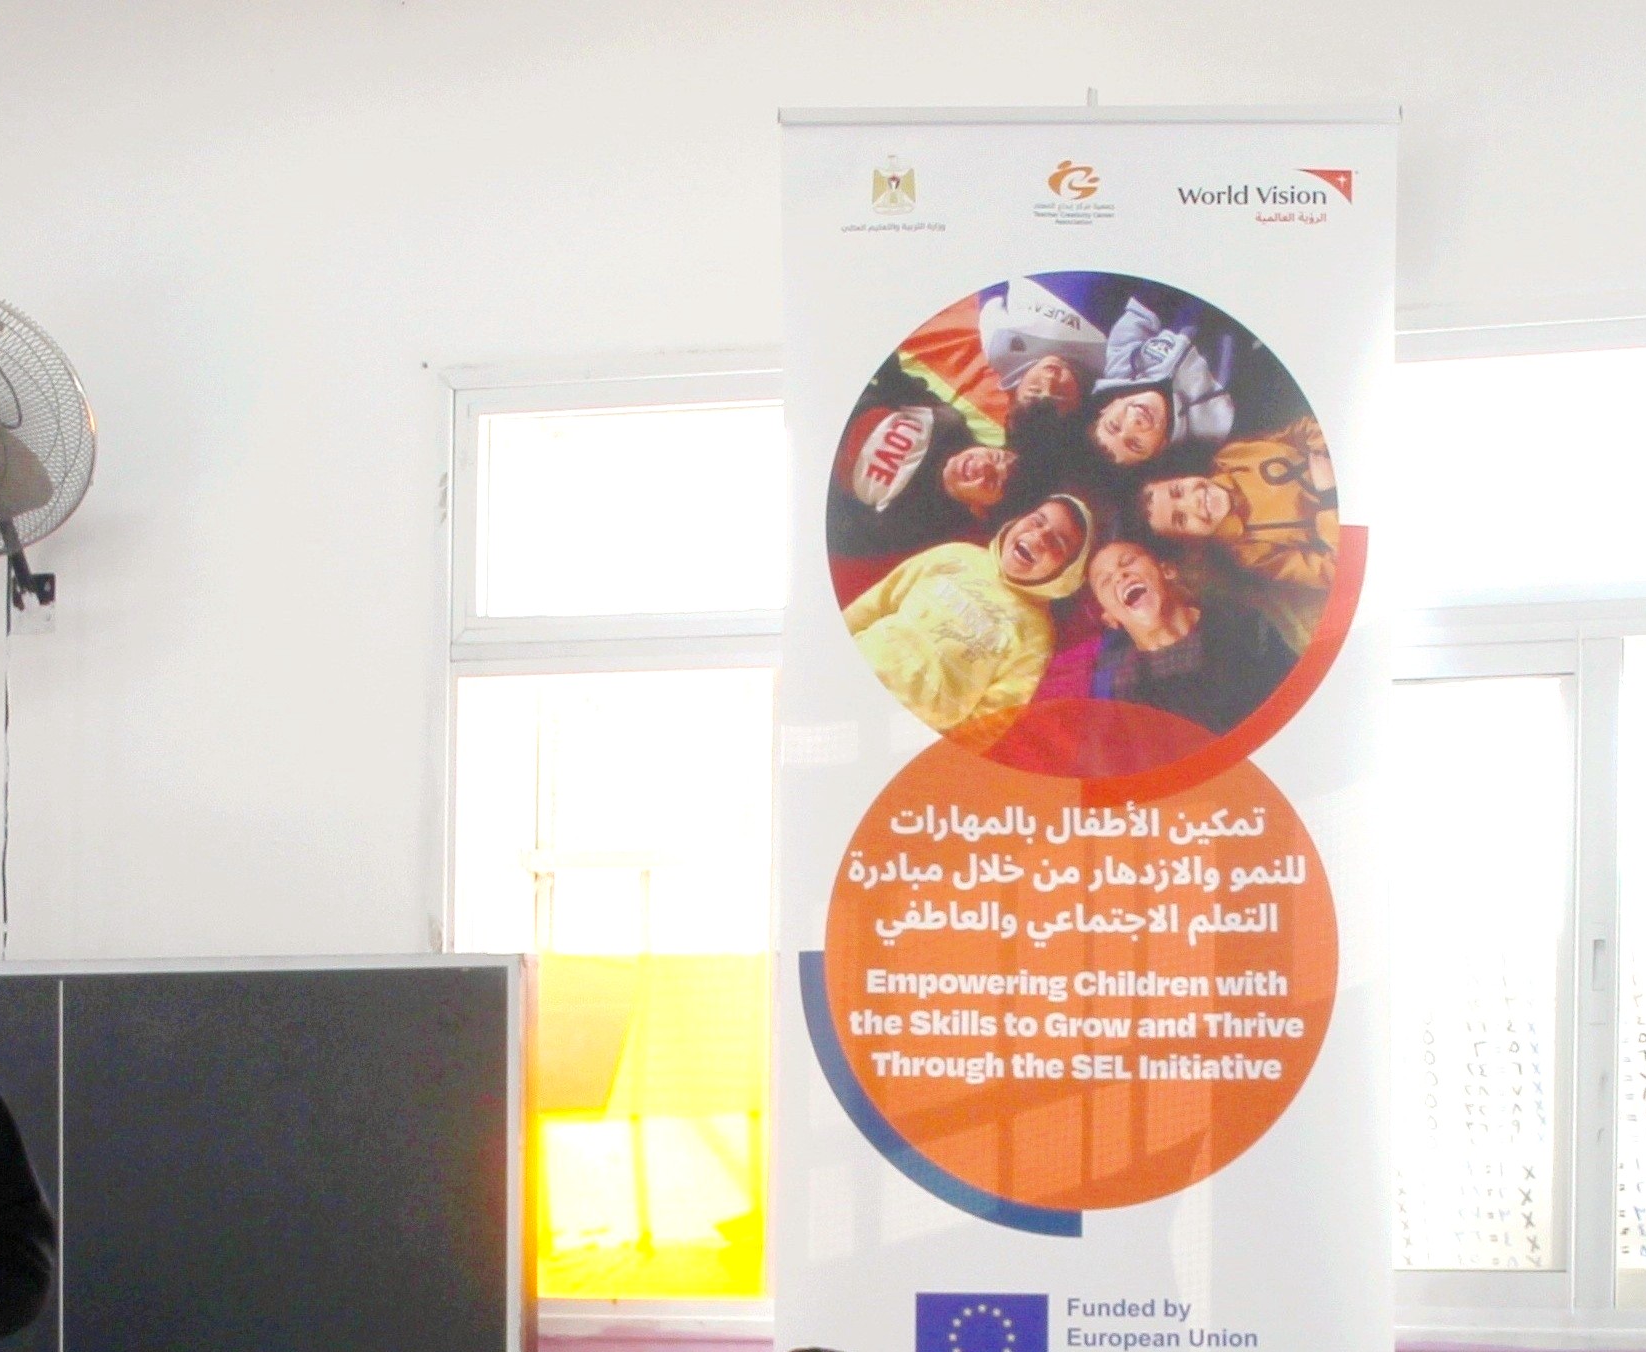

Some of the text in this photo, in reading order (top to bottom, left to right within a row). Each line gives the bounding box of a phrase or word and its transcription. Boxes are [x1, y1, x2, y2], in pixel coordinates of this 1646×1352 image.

[1178, 185, 1327, 205] World Vision
[866, 418, 923, 486] LOVE
[891, 800, 1265, 846] تمكين الأطفال بالمهارات
[848, 850, 1307, 894] للنمو والازدهار من خلال مبادرة
[875, 900, 1278, 948] التعلم الاجتماعي والعاطفي
[865, 968, 1288, 1002] Empowering Children with
[850, 1009, 1304, 1040] the Skills to Grow and Thrive
[871, 1051, 1283, 1086] Through the SEL Initiative
[1066, 1298, 1191, 1322] Funded by
[1066, 1328, 1258, 1352] European Union
